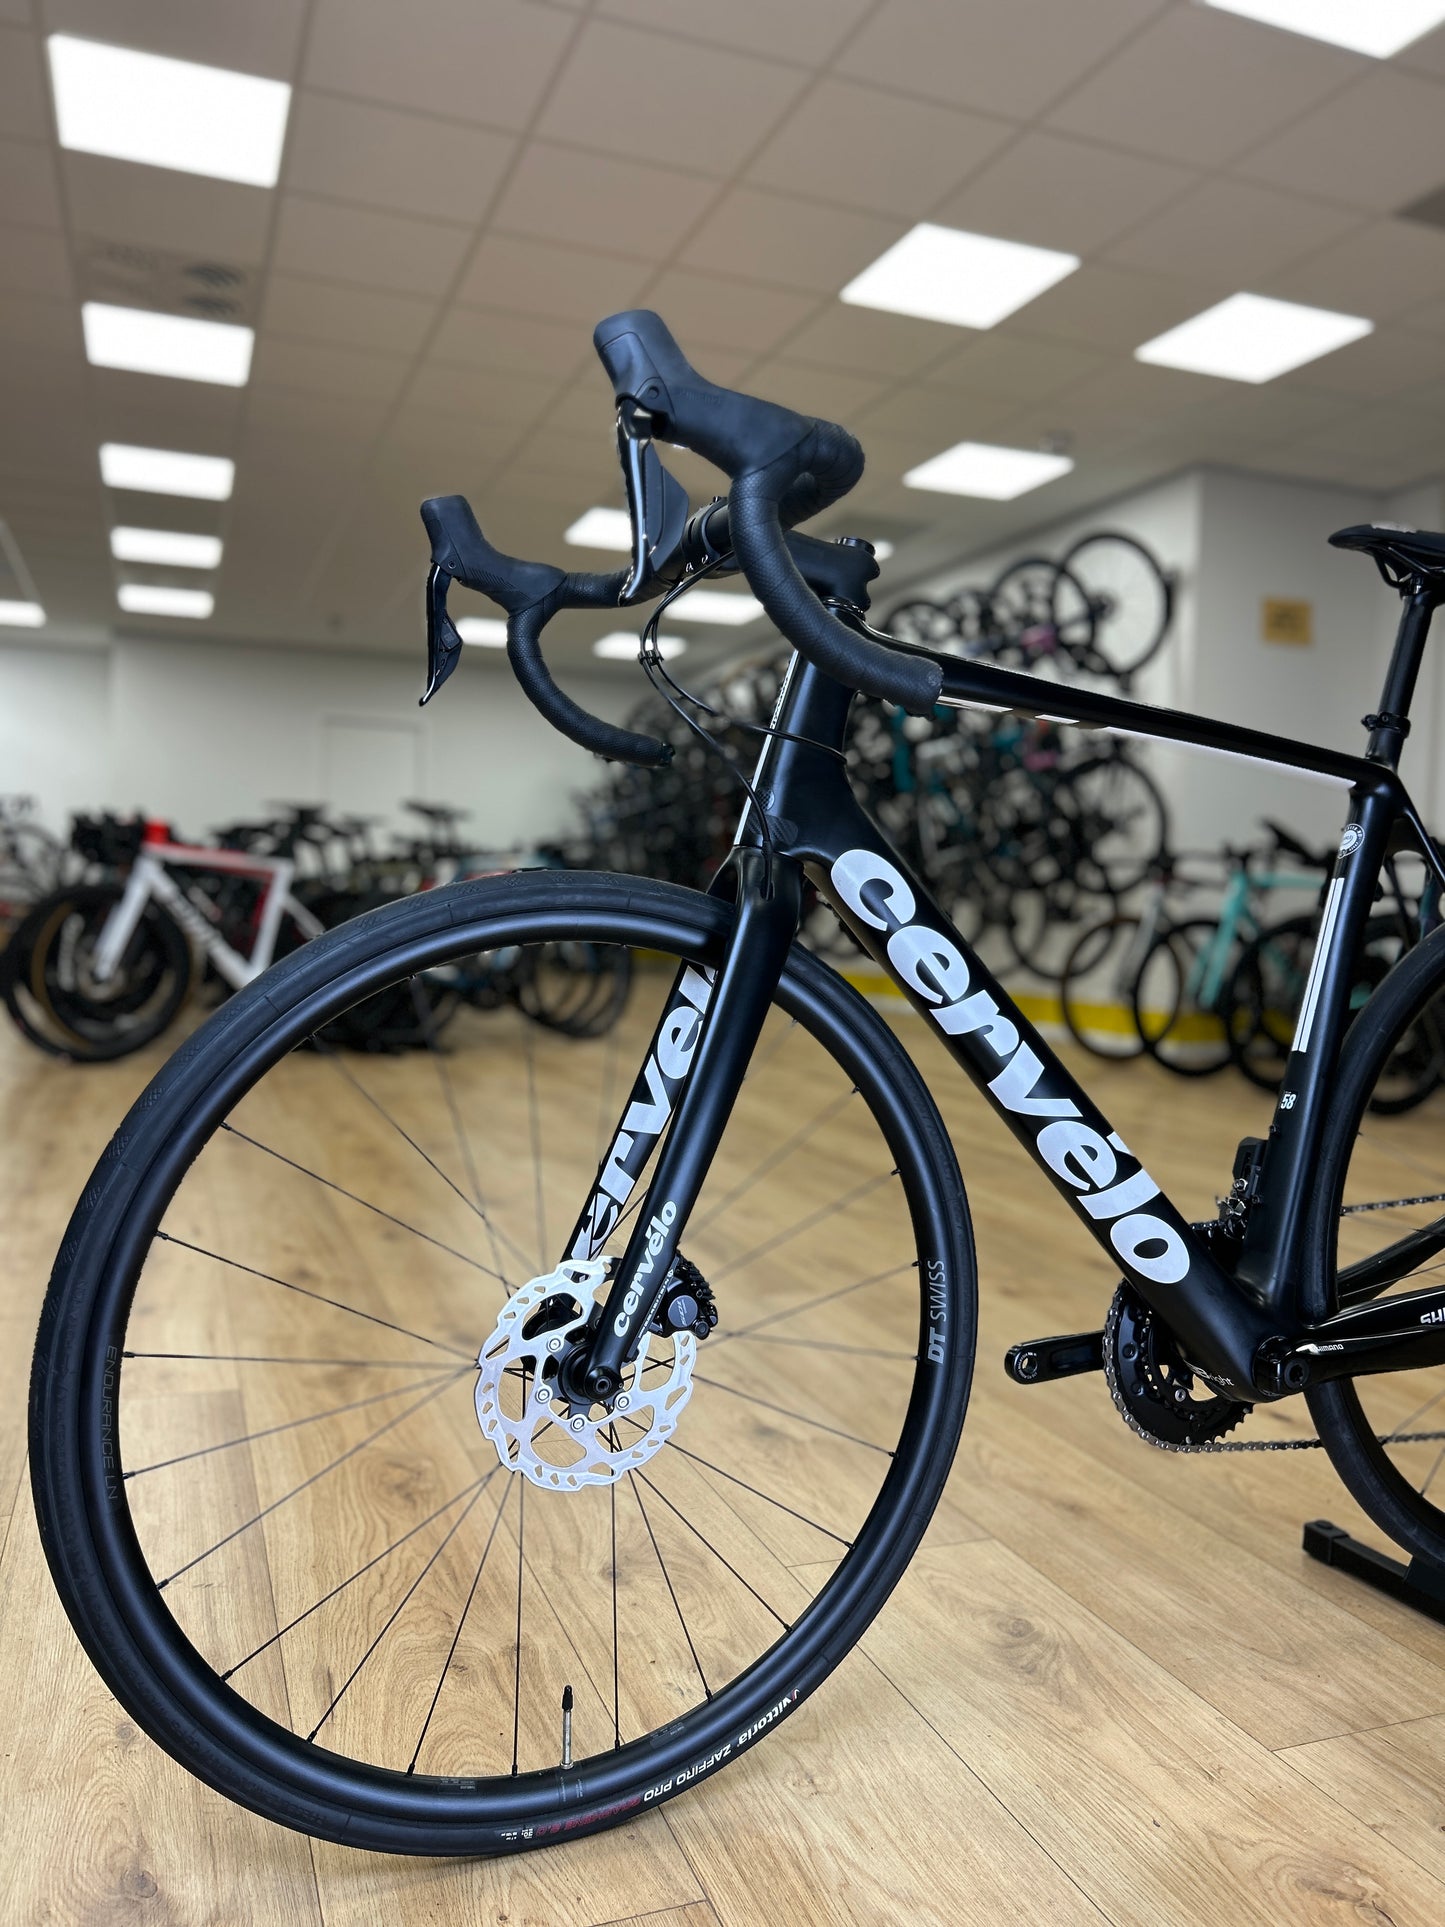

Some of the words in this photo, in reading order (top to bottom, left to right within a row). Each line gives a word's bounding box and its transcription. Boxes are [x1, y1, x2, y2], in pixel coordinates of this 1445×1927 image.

[830, 848, 1190, 1285] cervélo
[1280, 1093, 1297, 1110] 58
[613, 1200, 677, 1338] cervélo
[927, 1260, 947, 1322] SWISS
[927, 1326, 946, 1364] DT
[101, 1345, 118, 1469] ENDURANCE
[105, 1475, 118, 1500] LN
[738, 1696, 791, 1746] vittoria
[677, 1744, 732, 1785] ZAFFIRO
[643, 1779, 673, 1802] PRO
